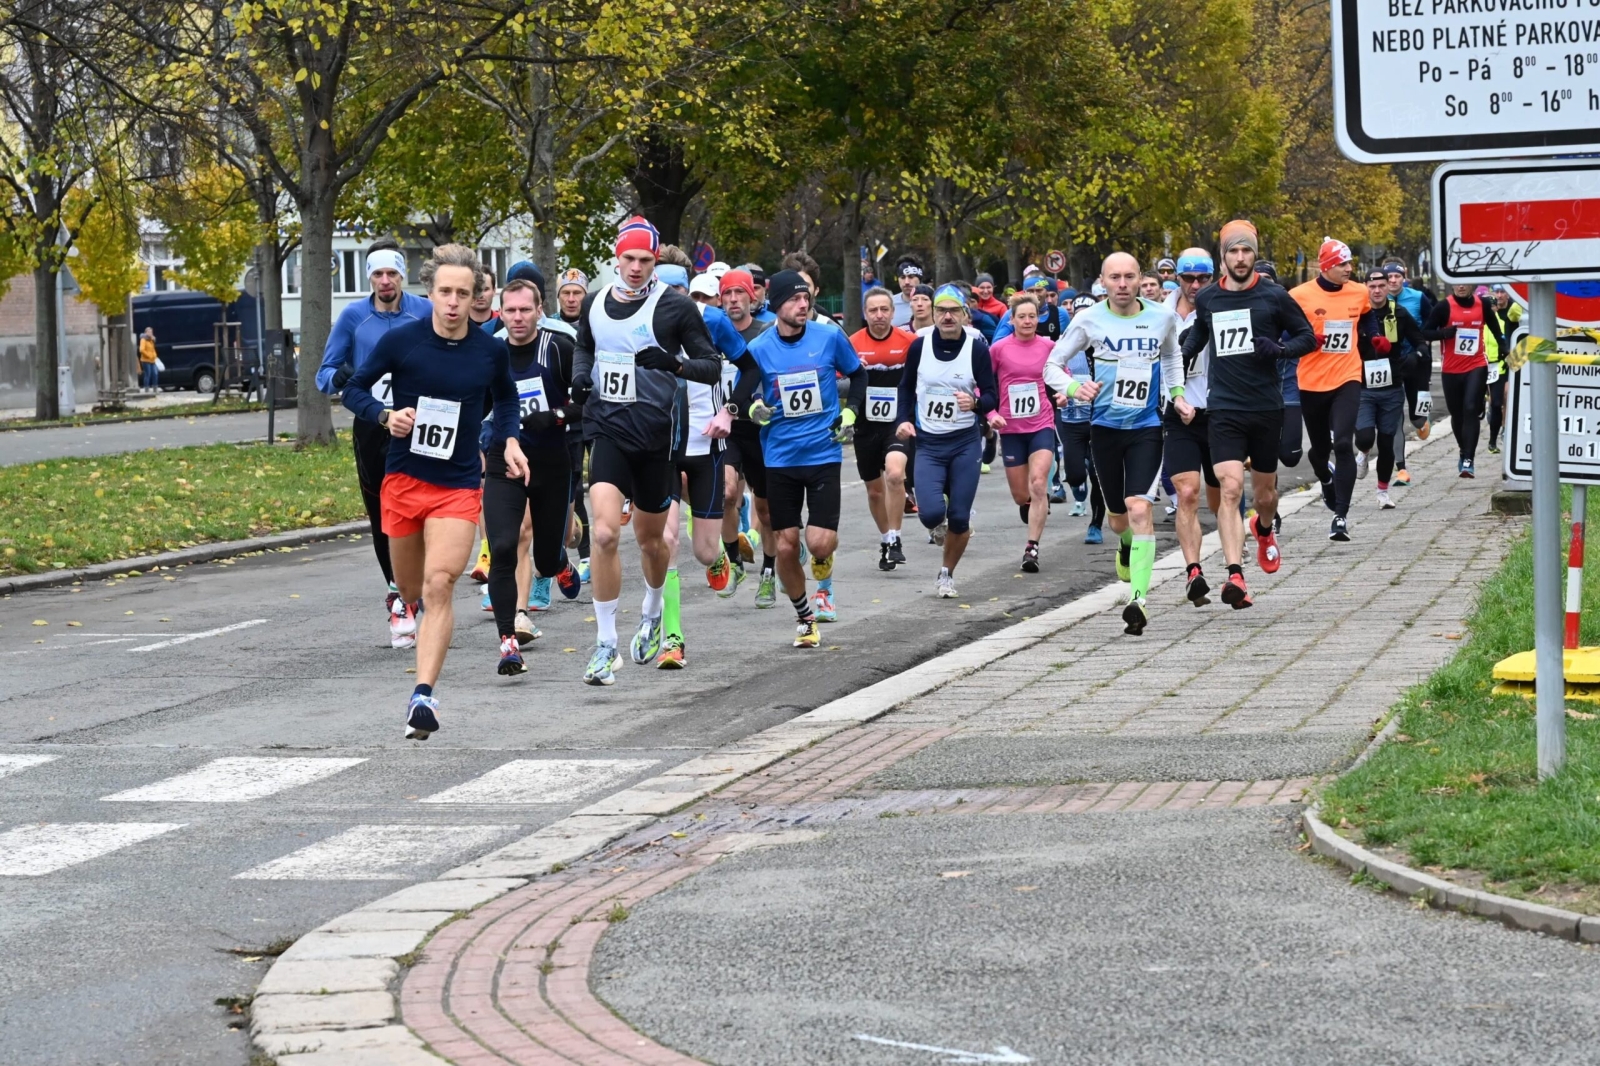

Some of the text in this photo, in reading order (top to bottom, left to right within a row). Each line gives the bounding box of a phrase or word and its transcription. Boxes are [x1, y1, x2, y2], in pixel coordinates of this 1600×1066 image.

[1389, 0, 1424, 17] BEZ
[1373, 29, 1425, 53] NEBO
[1433, 19, 1508, 50] PLATNÉ
[1419, 61, 1442, 83] Po
[1468, 57, 1491, 81] Pá
[1445, 94, 1468, 117] So
[1219, 326, 1249, 350] 177
[1324, 333, 1349, 349] 152
[1459, 339, 1474, 352] 62
[603, 371, 629, 396] 151
[1370, 370, 1388, 385] 131
[789, 389, 813, 411] 69
[1115, 379, 1149, 401] 126
[871, 401, 891, 418] 60
[927, 400, 955, 419] 145
[1014, 395, 1036, 414] 119
[416, 423, 455, 450] 167
[1568, 443, 1583, 457] do
